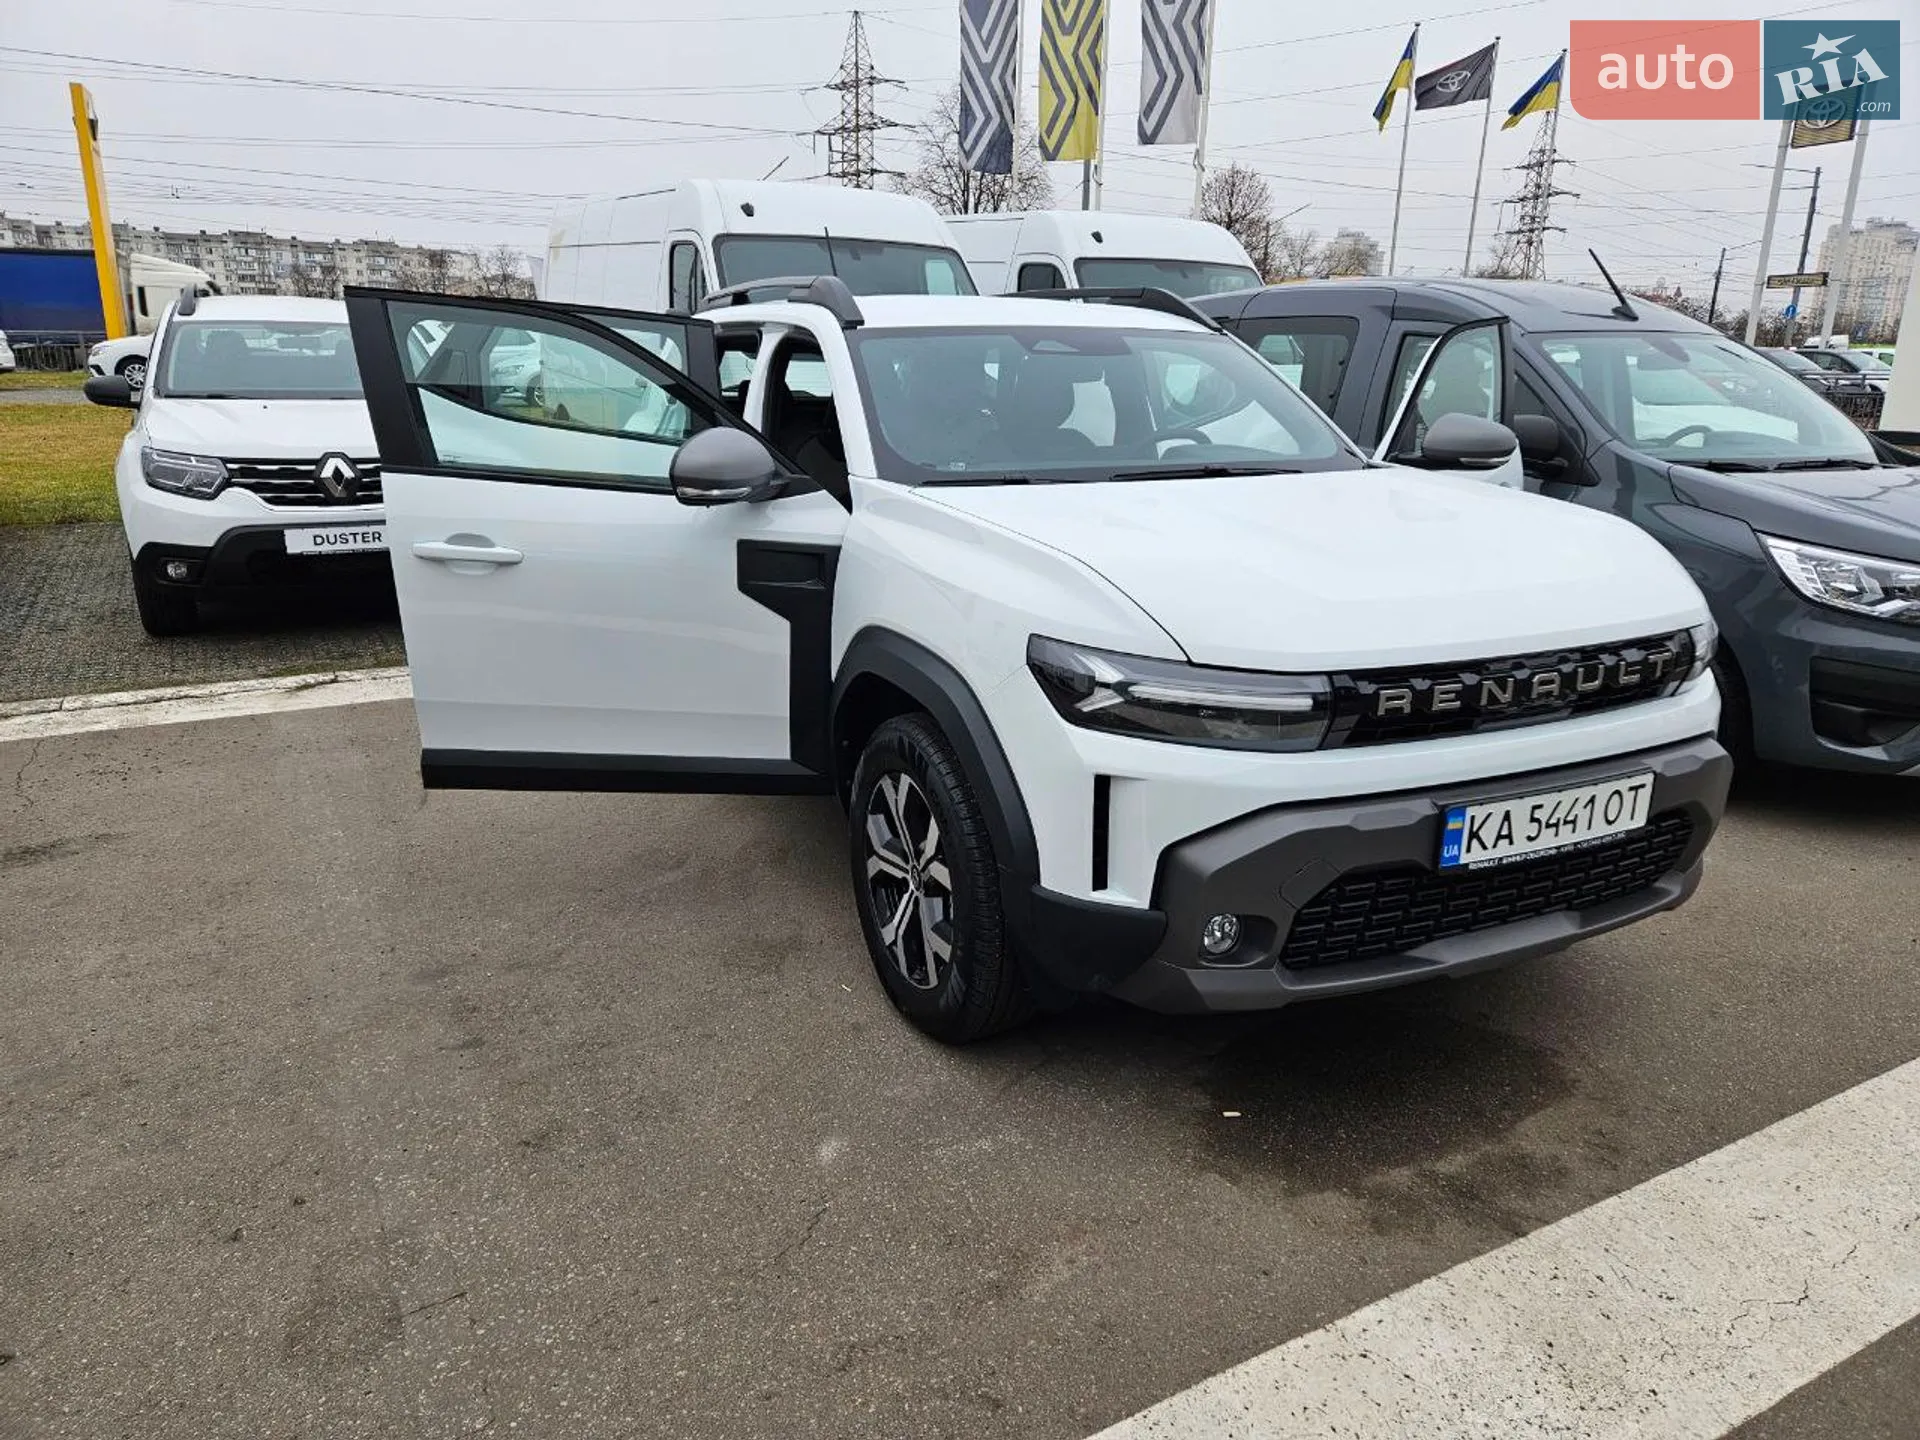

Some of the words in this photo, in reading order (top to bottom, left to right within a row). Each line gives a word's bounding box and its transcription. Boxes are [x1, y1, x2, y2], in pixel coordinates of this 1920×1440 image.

[313, 531, 382, 546] DUSTER
[1377, 652, 1673, 716] RENAULT
[1465, 809, 1514, 854] KA
[1444, 845, 1459, 858] UA
